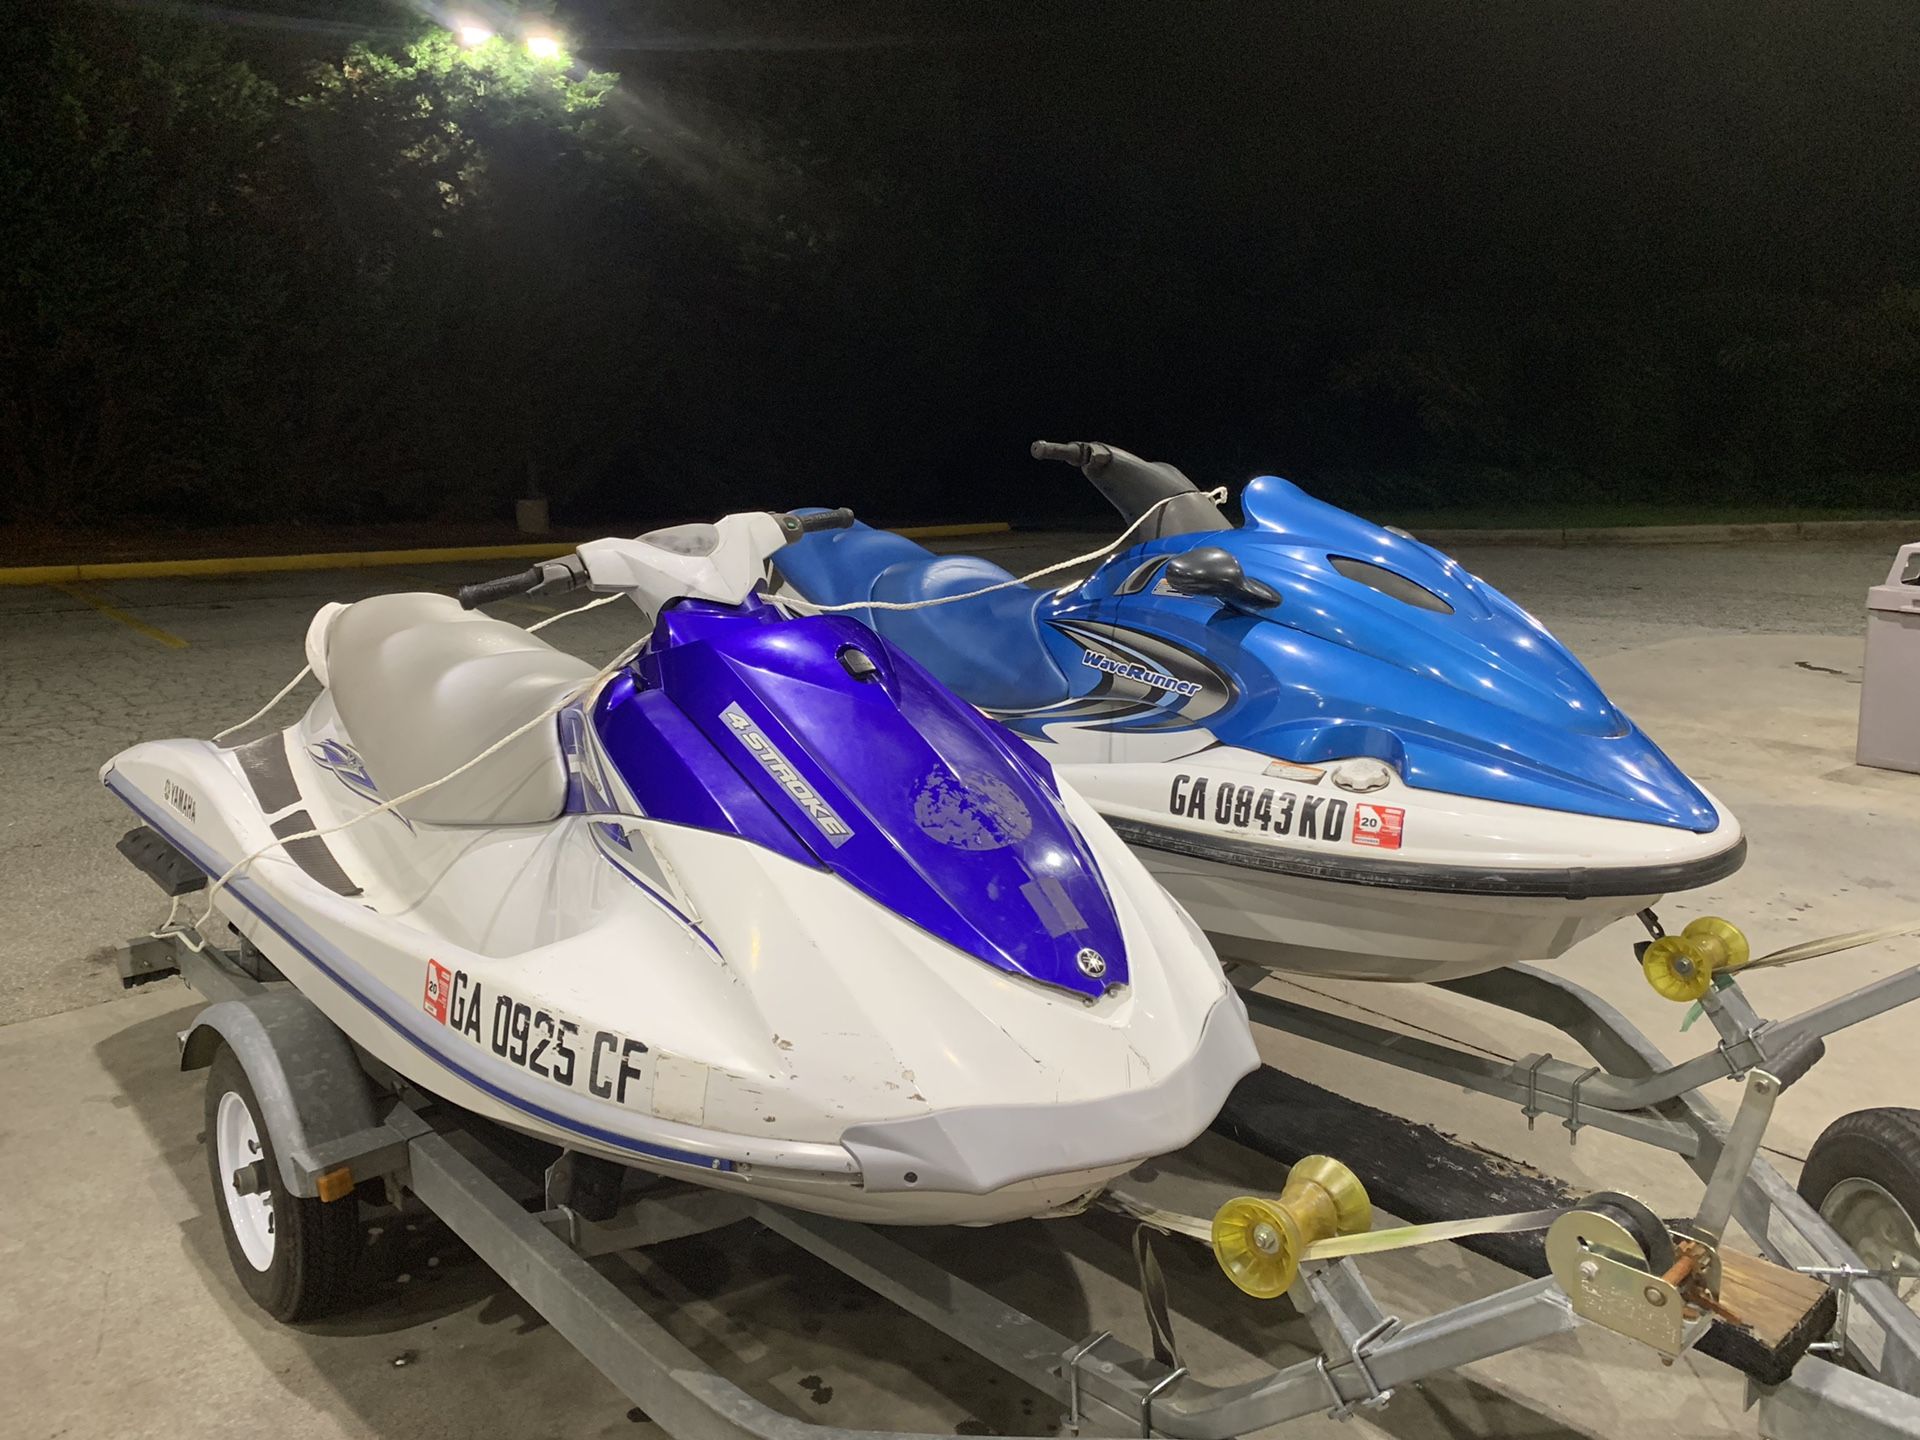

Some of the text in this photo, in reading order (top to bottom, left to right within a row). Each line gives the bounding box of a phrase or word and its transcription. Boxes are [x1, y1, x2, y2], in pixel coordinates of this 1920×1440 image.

[1083, 650, 1202, 696] WaveRunner
[726, 711, 850, 836] 4 STROKE
[170, 781, 196, 824] YAMAHA
[1169, 774, 1209, 820] GA
[1215, 782, 1297, 836] 0843
[1298, 794, 1348, 842] KD
[1361, 817, 1377, 828] 20
[450, 970, 482, 1044] GA
[492, 995, 580, 1087] 0925
[588, 1030, 649, 1104] CF
